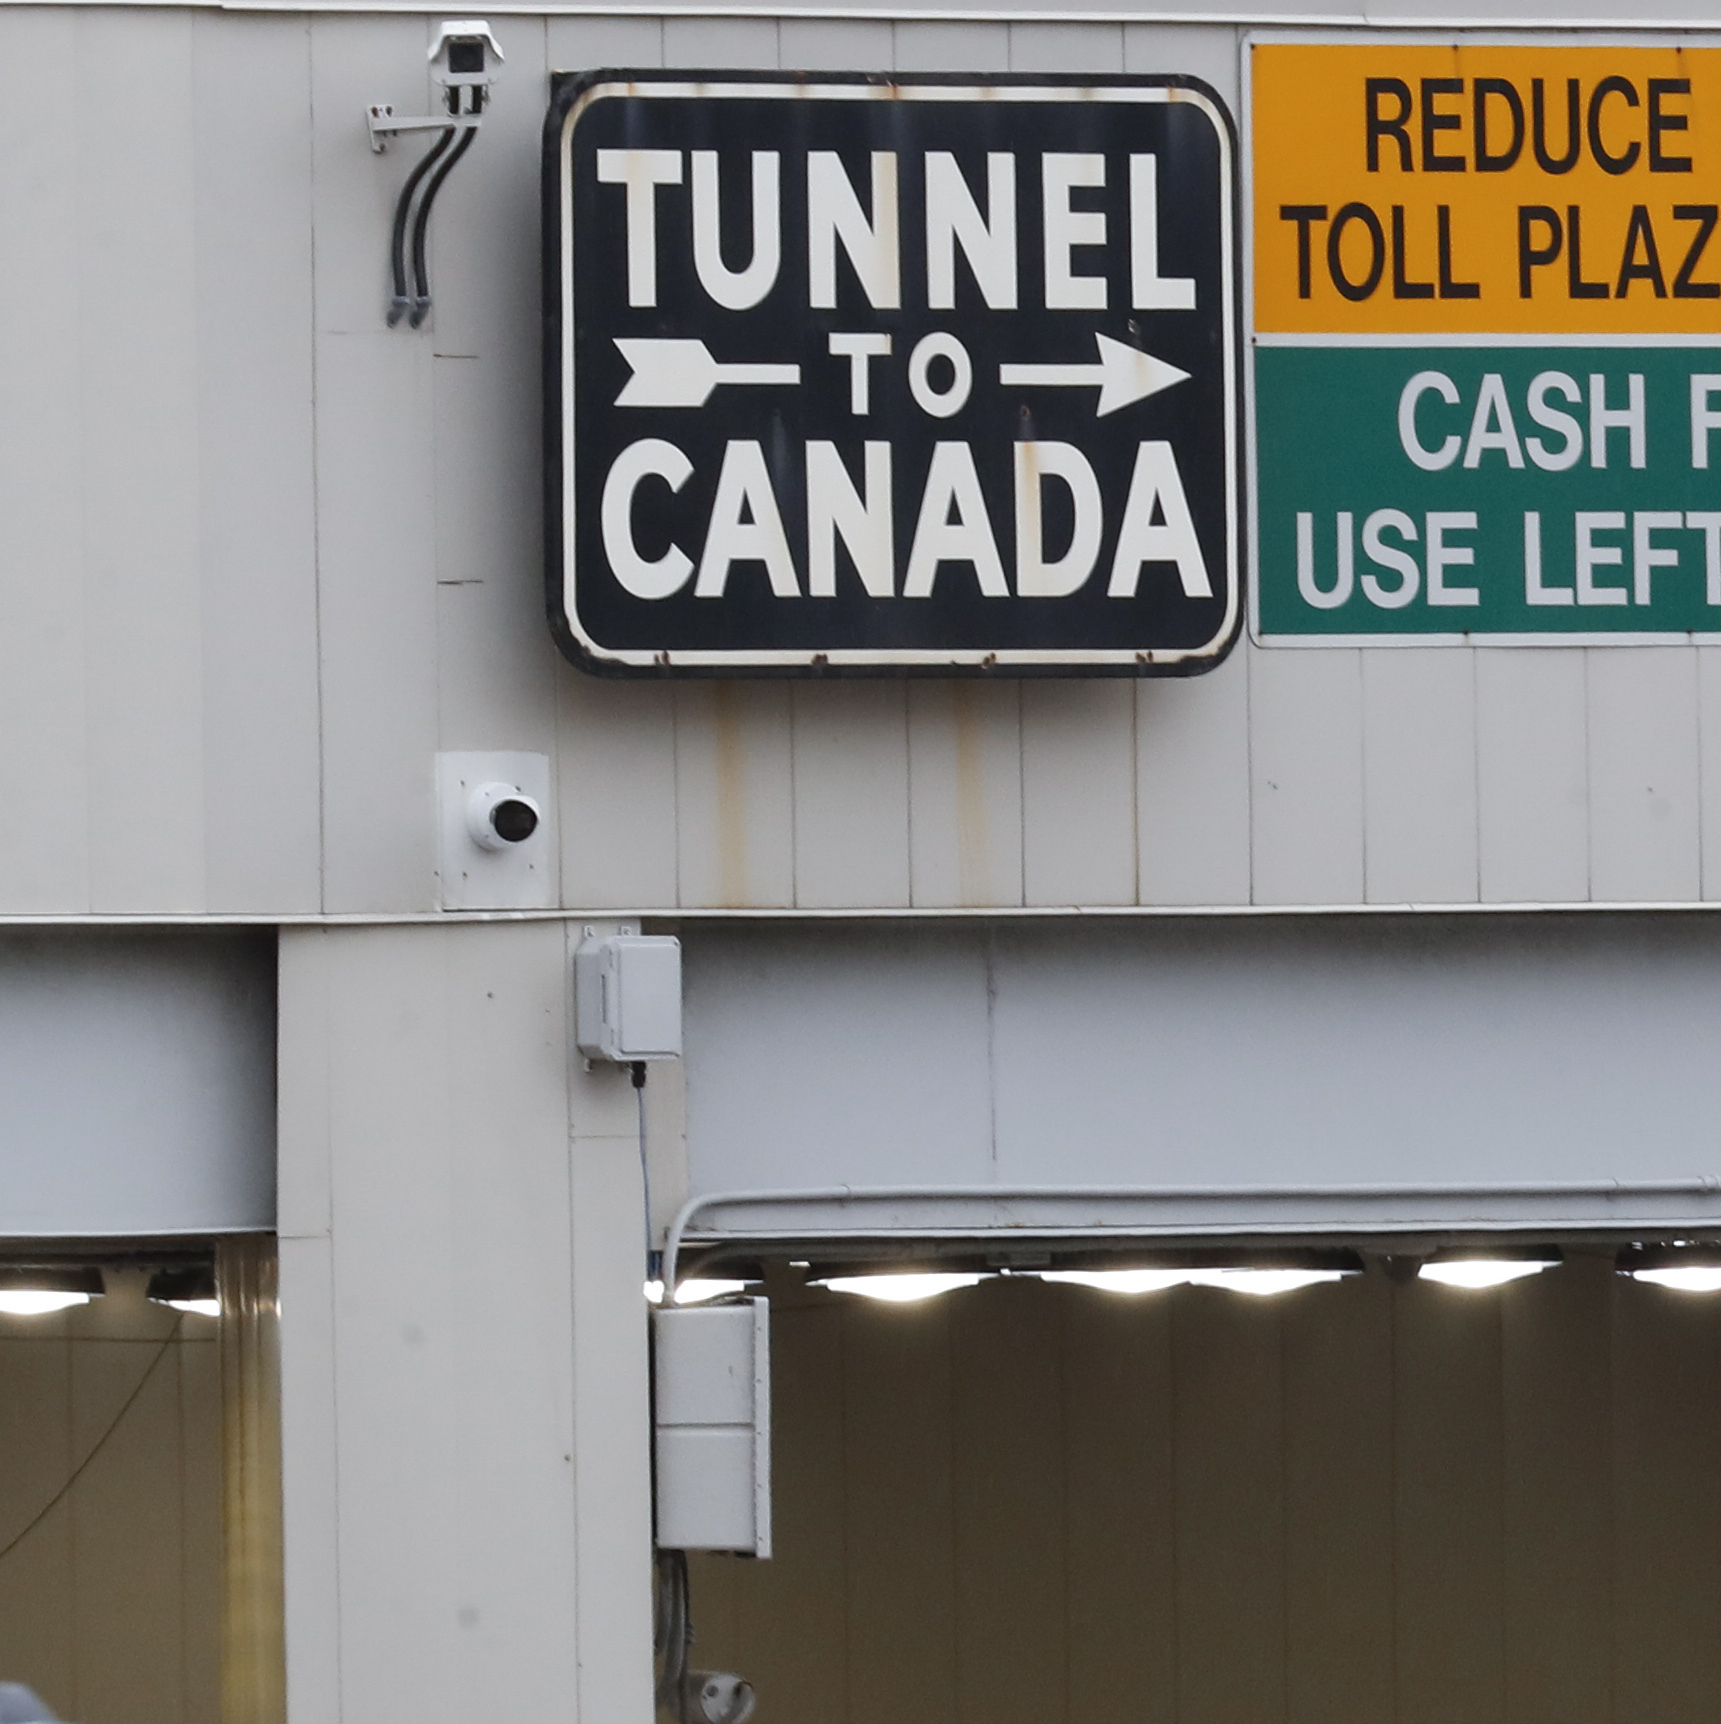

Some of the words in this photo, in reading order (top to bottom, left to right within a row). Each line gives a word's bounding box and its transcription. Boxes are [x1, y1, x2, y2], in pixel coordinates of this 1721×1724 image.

[1365, 75, 1693, 175] REDUCE
[597, 148, 1196, 311] TUNNEL
[1279, 203, 1481, 301] TOLL
[830, 332, 973, 417] TO
[1398, 370, 1646, 471] CASH
[601, 438, 1213, 600] CANADA
[1296, 509, 1479, 609] USE
